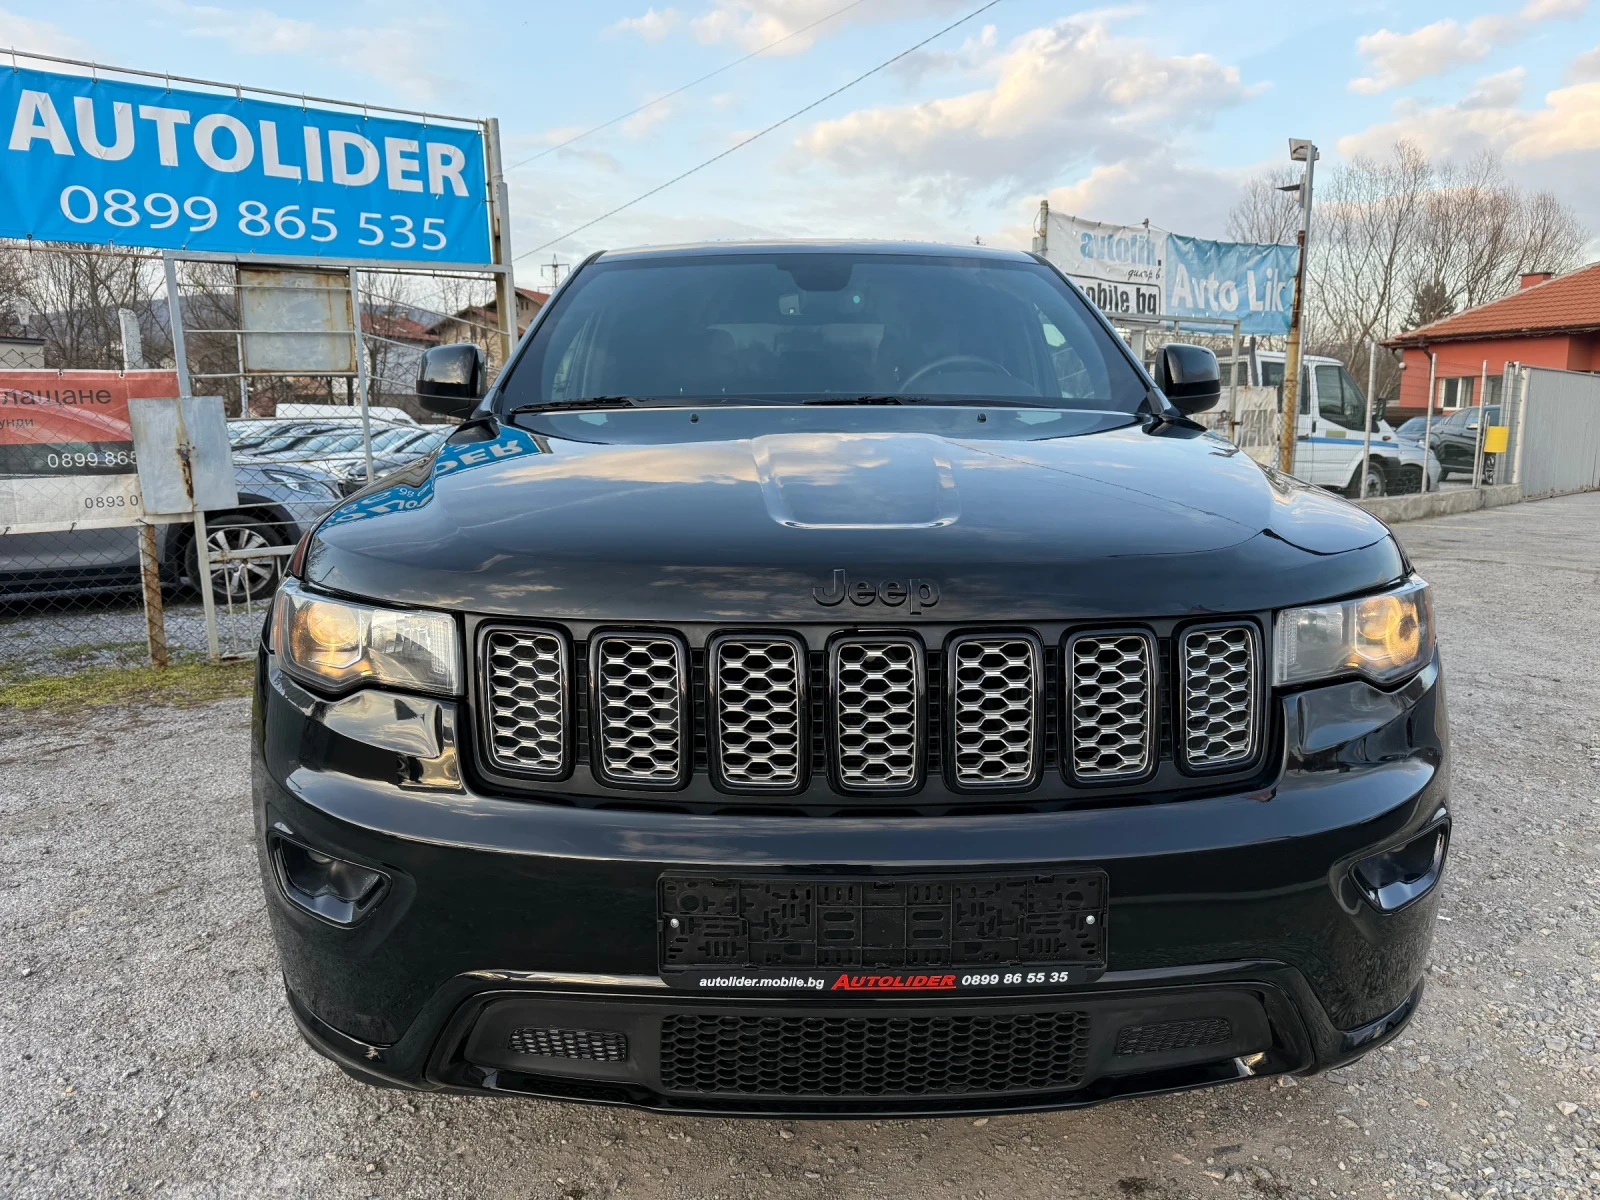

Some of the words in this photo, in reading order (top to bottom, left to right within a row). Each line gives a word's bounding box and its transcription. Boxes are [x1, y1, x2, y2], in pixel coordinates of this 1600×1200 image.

[8, 88, 470, 197] AUTOLIDER
[60, 185, 217, 231] 0899
[238, 201, 338, 241] 865
[358, 212, 447, 250] 535
[1171, 263, 1239, 312] Avto
[1247, 267, 1287, 312] Lik
[48, 452, 98, 468] 0899
[84, 495, 125, 509] 0893
[812, 568, 940, 615] Jeep
[699, 976, 825, 990] autolider.mobile.bg
[831, 974, 957, 990] AUTOLIDER
[961, 974, 1000, 985] 0899
[1003, 973, 1023, 984] 86
[1026, 972, 1046, 983] 55
[1049, 971, 1069, 982] 35
